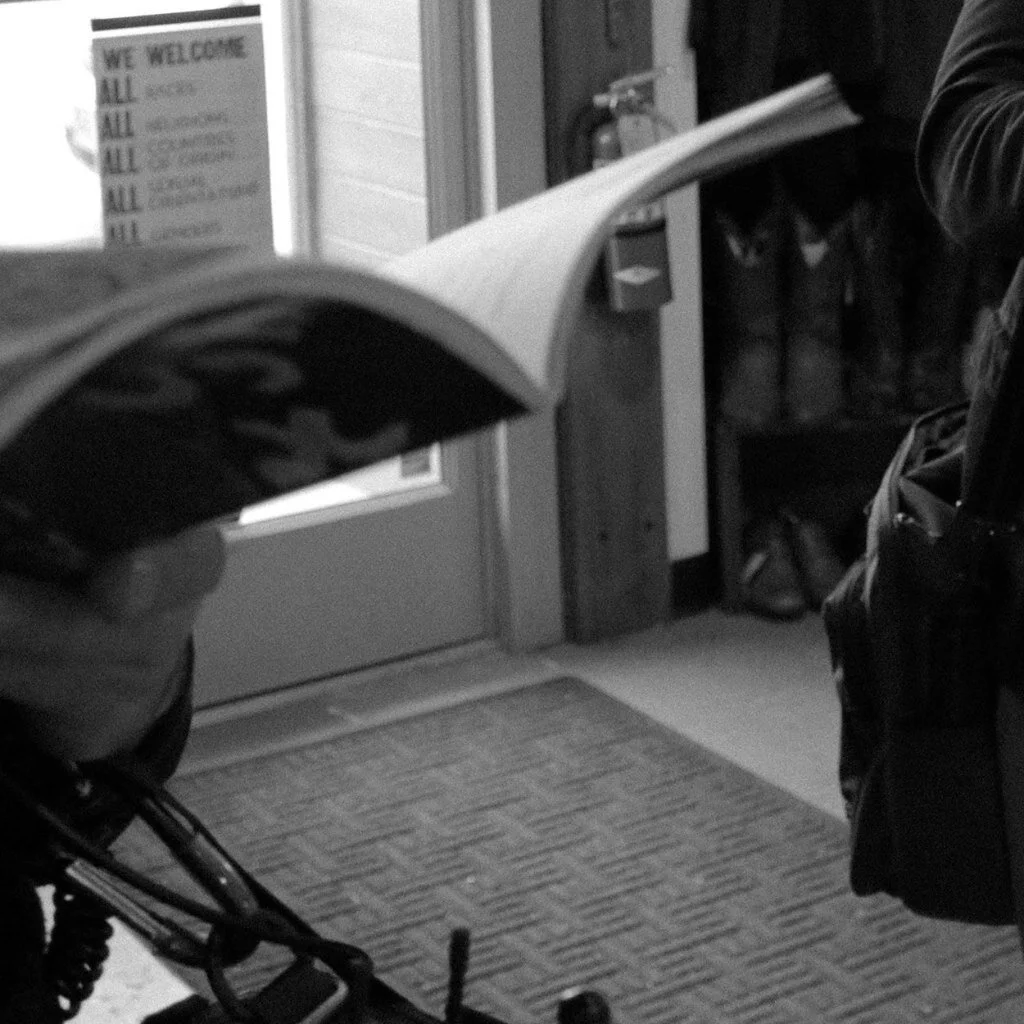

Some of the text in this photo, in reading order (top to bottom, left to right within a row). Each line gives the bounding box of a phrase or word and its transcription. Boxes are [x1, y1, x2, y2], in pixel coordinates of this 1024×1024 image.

[103, 35, 247, 70] WE WELCOME
[101, 75, 137, 105] ALL
[102, 109, 135, 139] ALL
[103, 146, 138, 175] ALL
[105, 183, 142, 214] ALL
